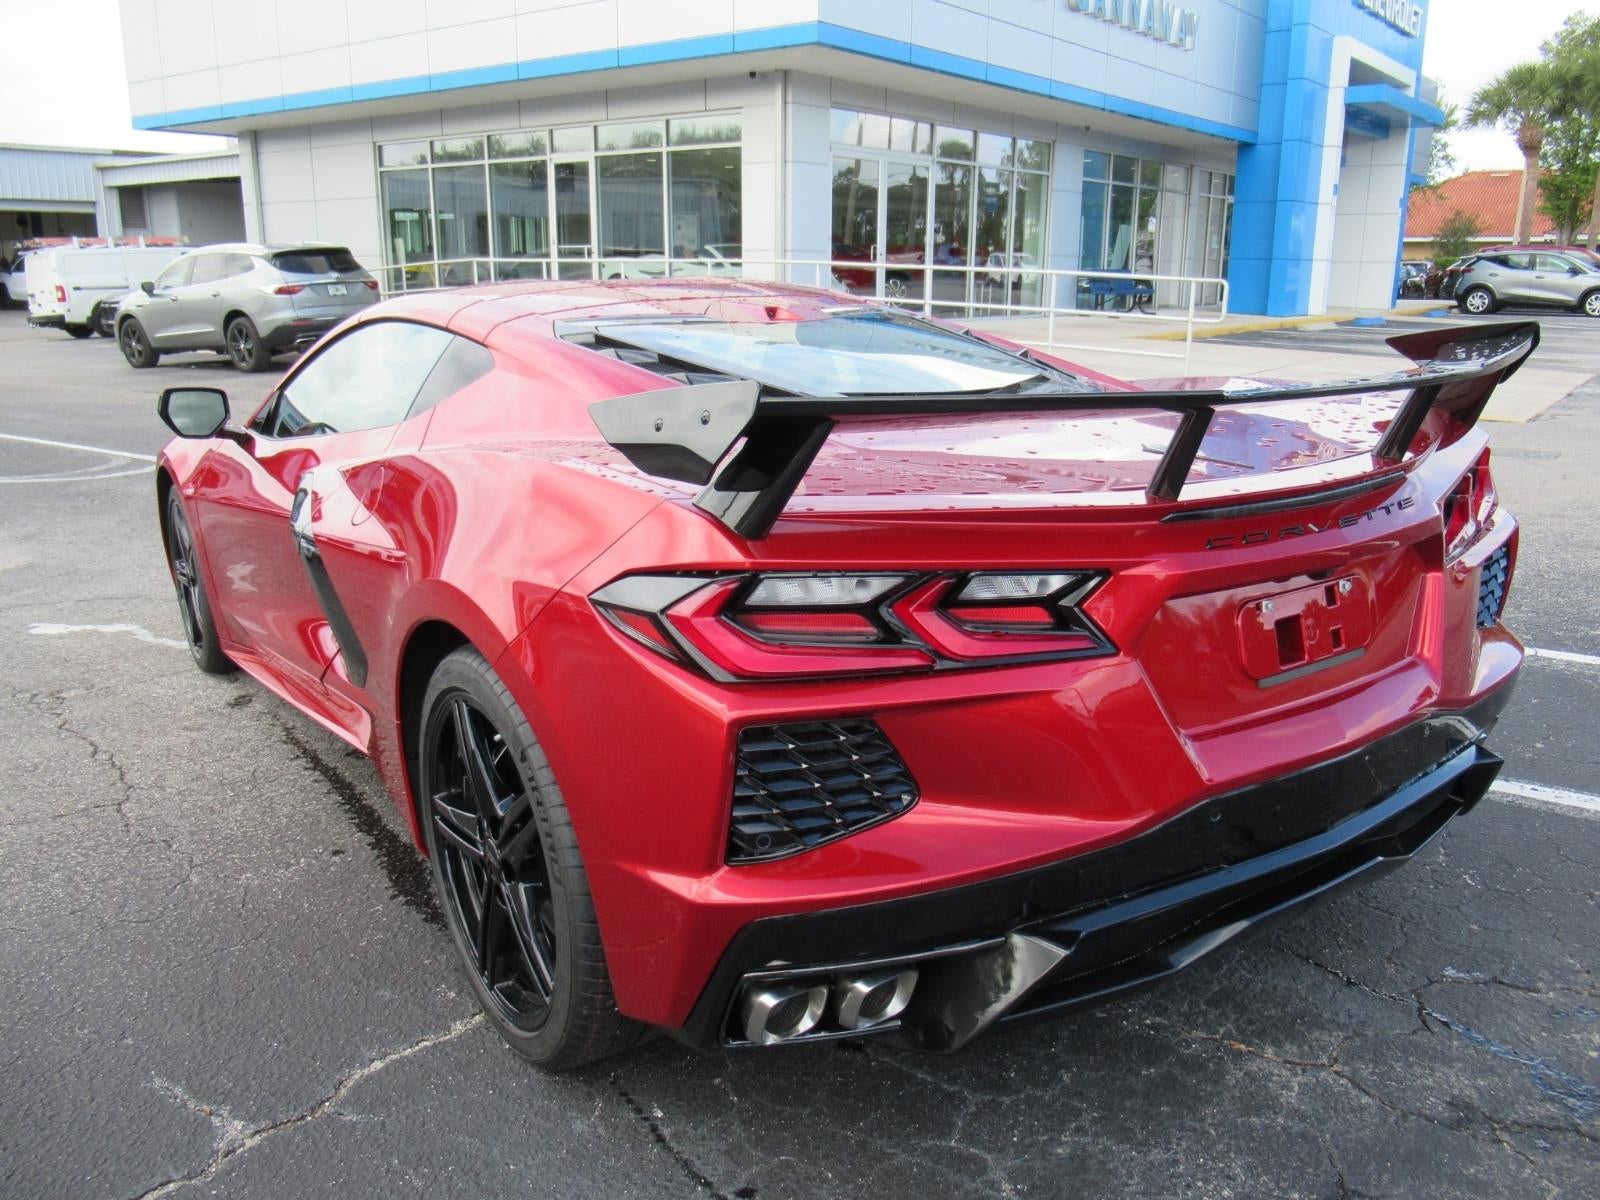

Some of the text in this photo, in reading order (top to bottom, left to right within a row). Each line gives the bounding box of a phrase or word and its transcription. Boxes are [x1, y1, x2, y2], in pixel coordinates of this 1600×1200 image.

[1068, 0, 1200, 51] NNAWAY
[1363, 0, 1423, 38] VROLET
[1206, 496, 1416, 550] CORVETTE
